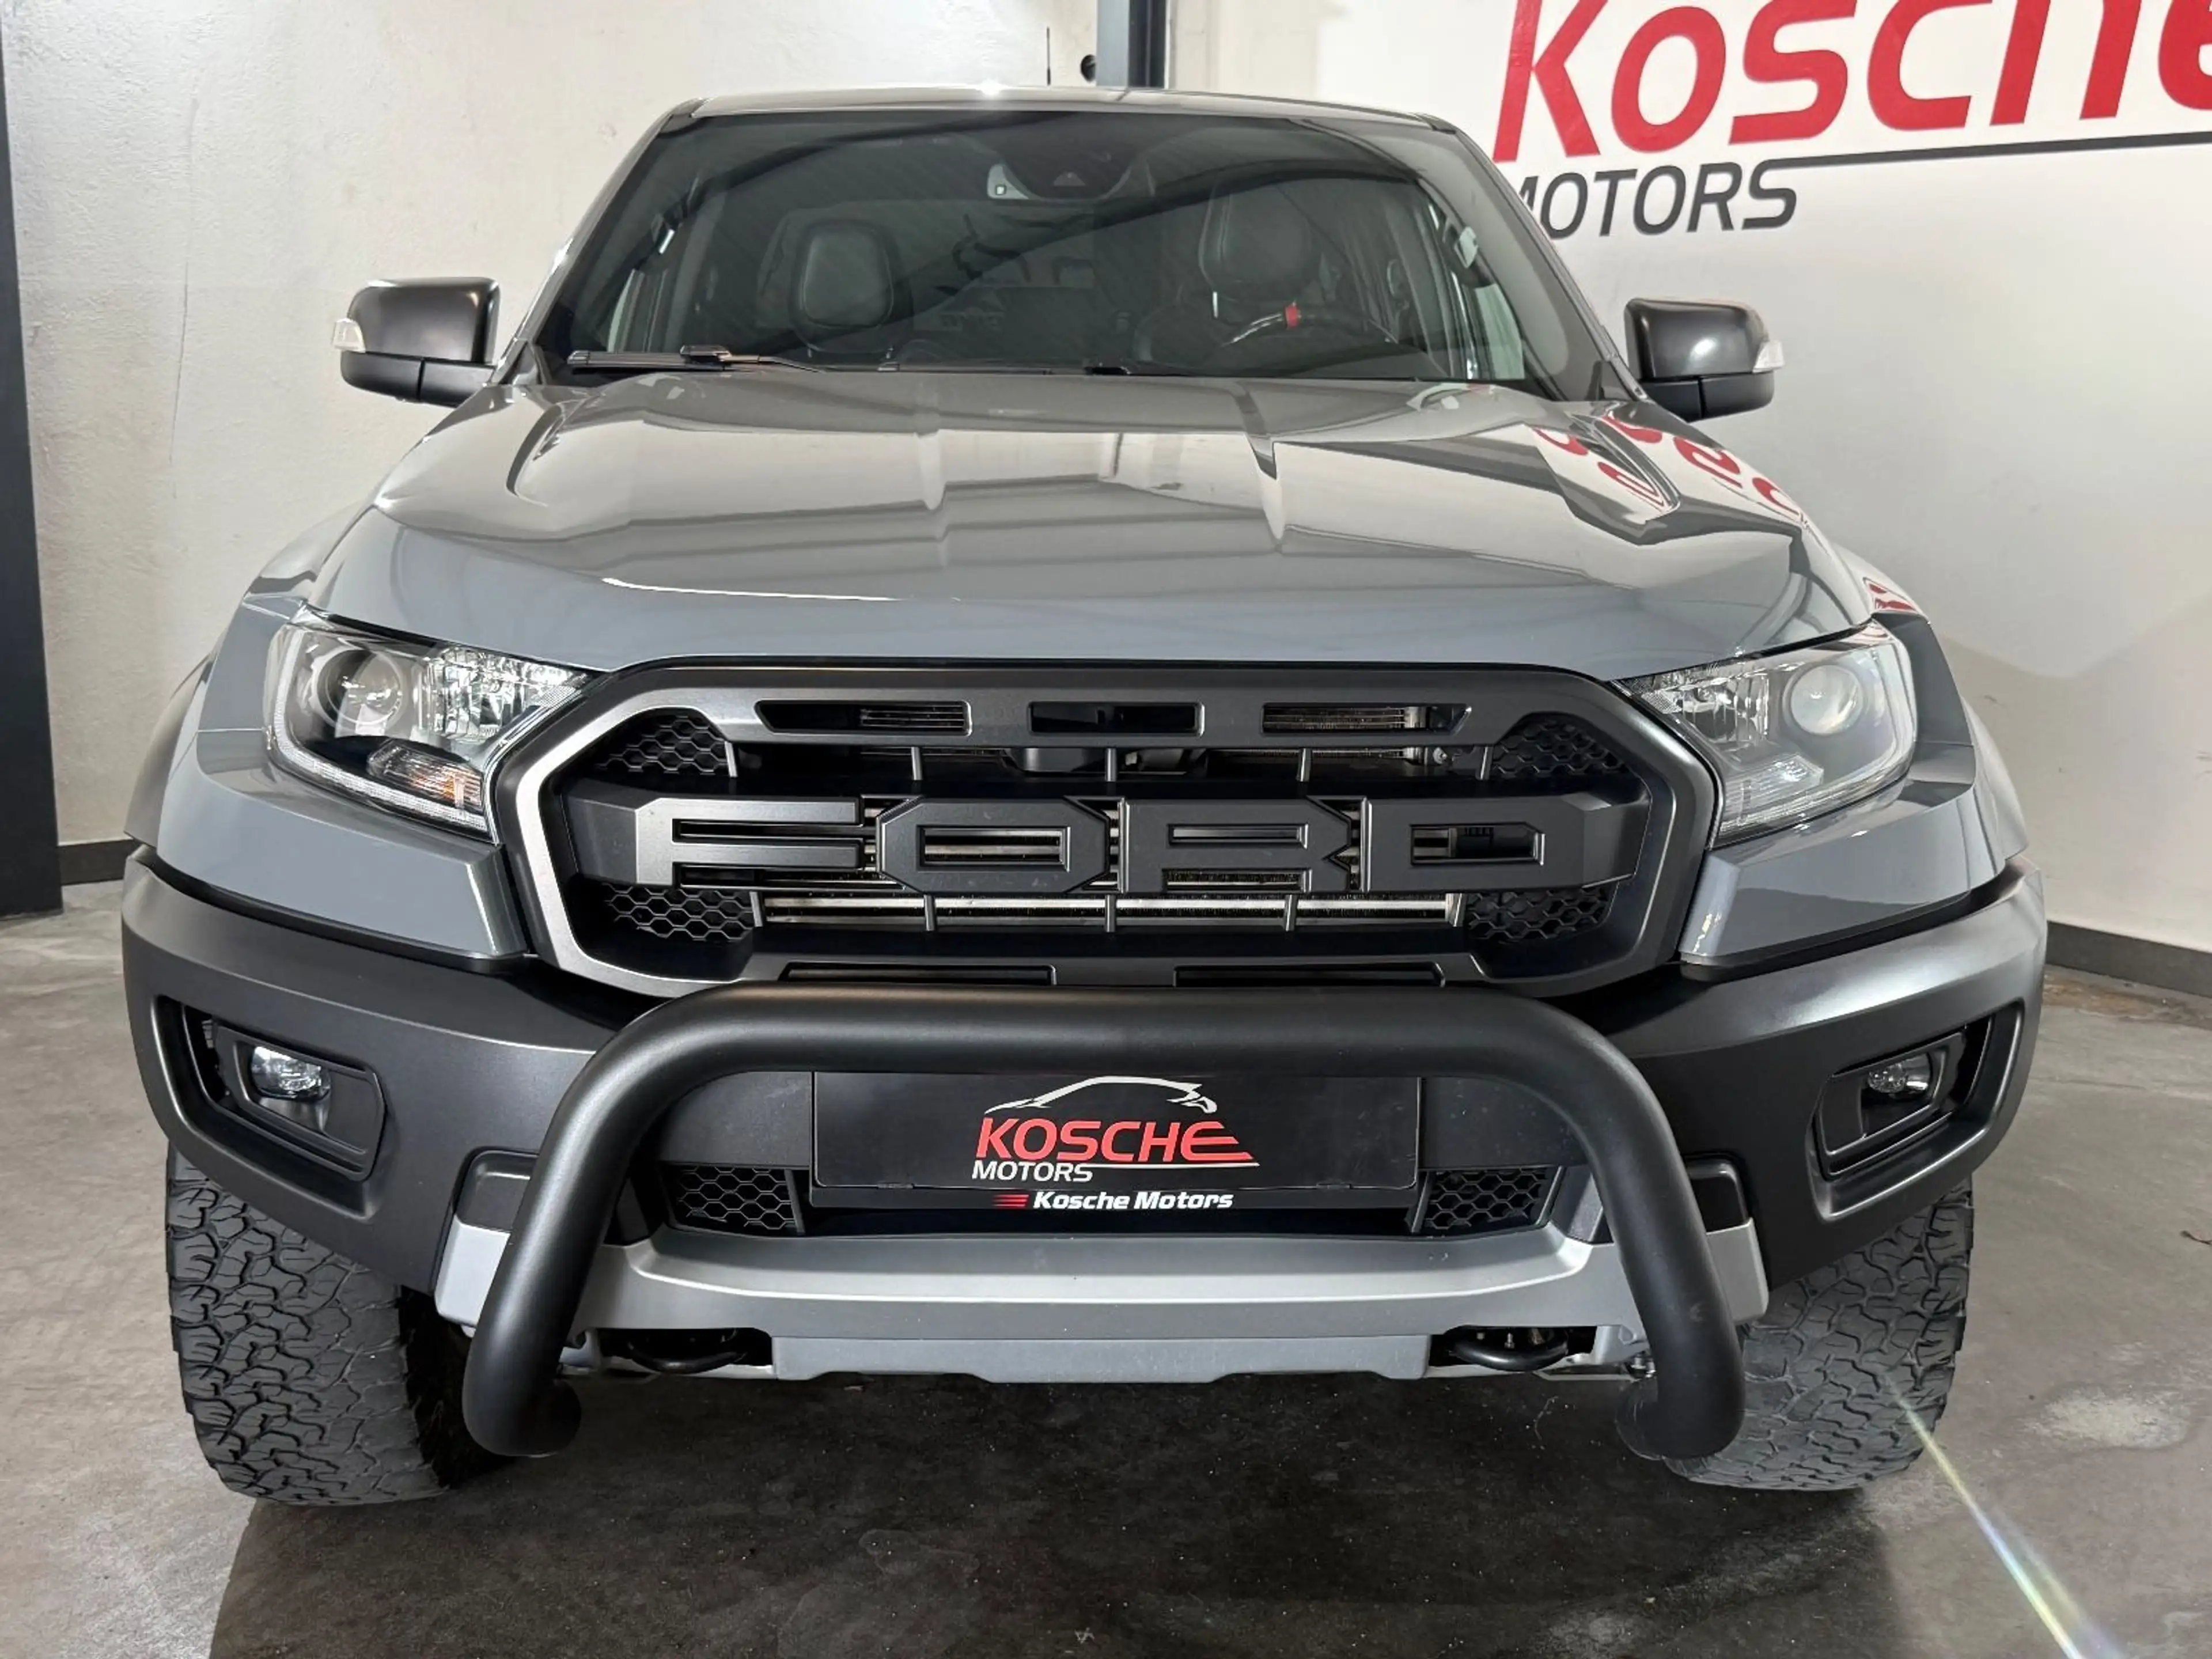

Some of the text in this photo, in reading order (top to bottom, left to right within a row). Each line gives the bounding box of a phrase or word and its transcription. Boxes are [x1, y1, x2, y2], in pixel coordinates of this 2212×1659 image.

[635, 796, 1582, 895] FORD
[976, 1118, 1253, 1162] KOSCHE
[972, 1160, 1093, 1182] MOTORS
[1033, 1191, 1234, 1210] Kosche Motors
